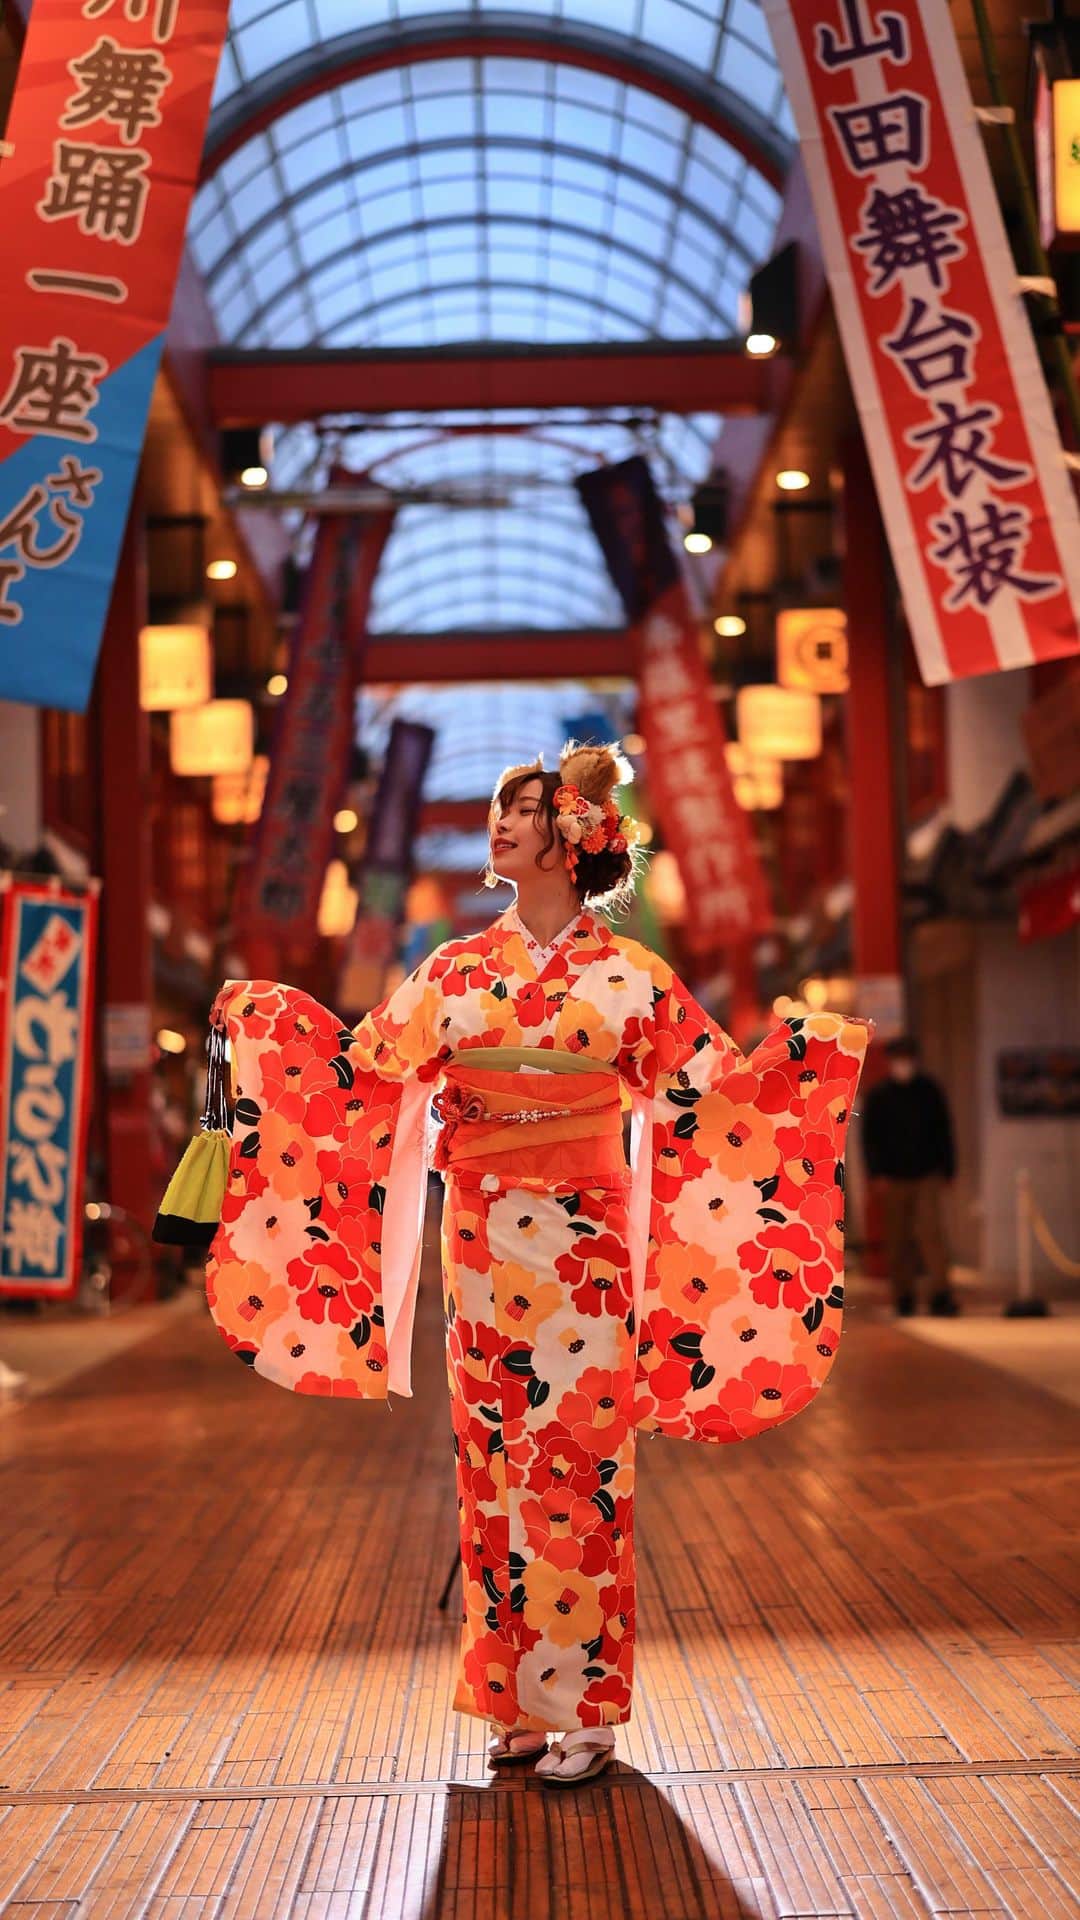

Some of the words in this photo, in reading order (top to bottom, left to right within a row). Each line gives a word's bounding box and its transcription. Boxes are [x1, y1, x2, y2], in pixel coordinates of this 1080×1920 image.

[816, 0, 1060, 608] 山田舞台衣装
